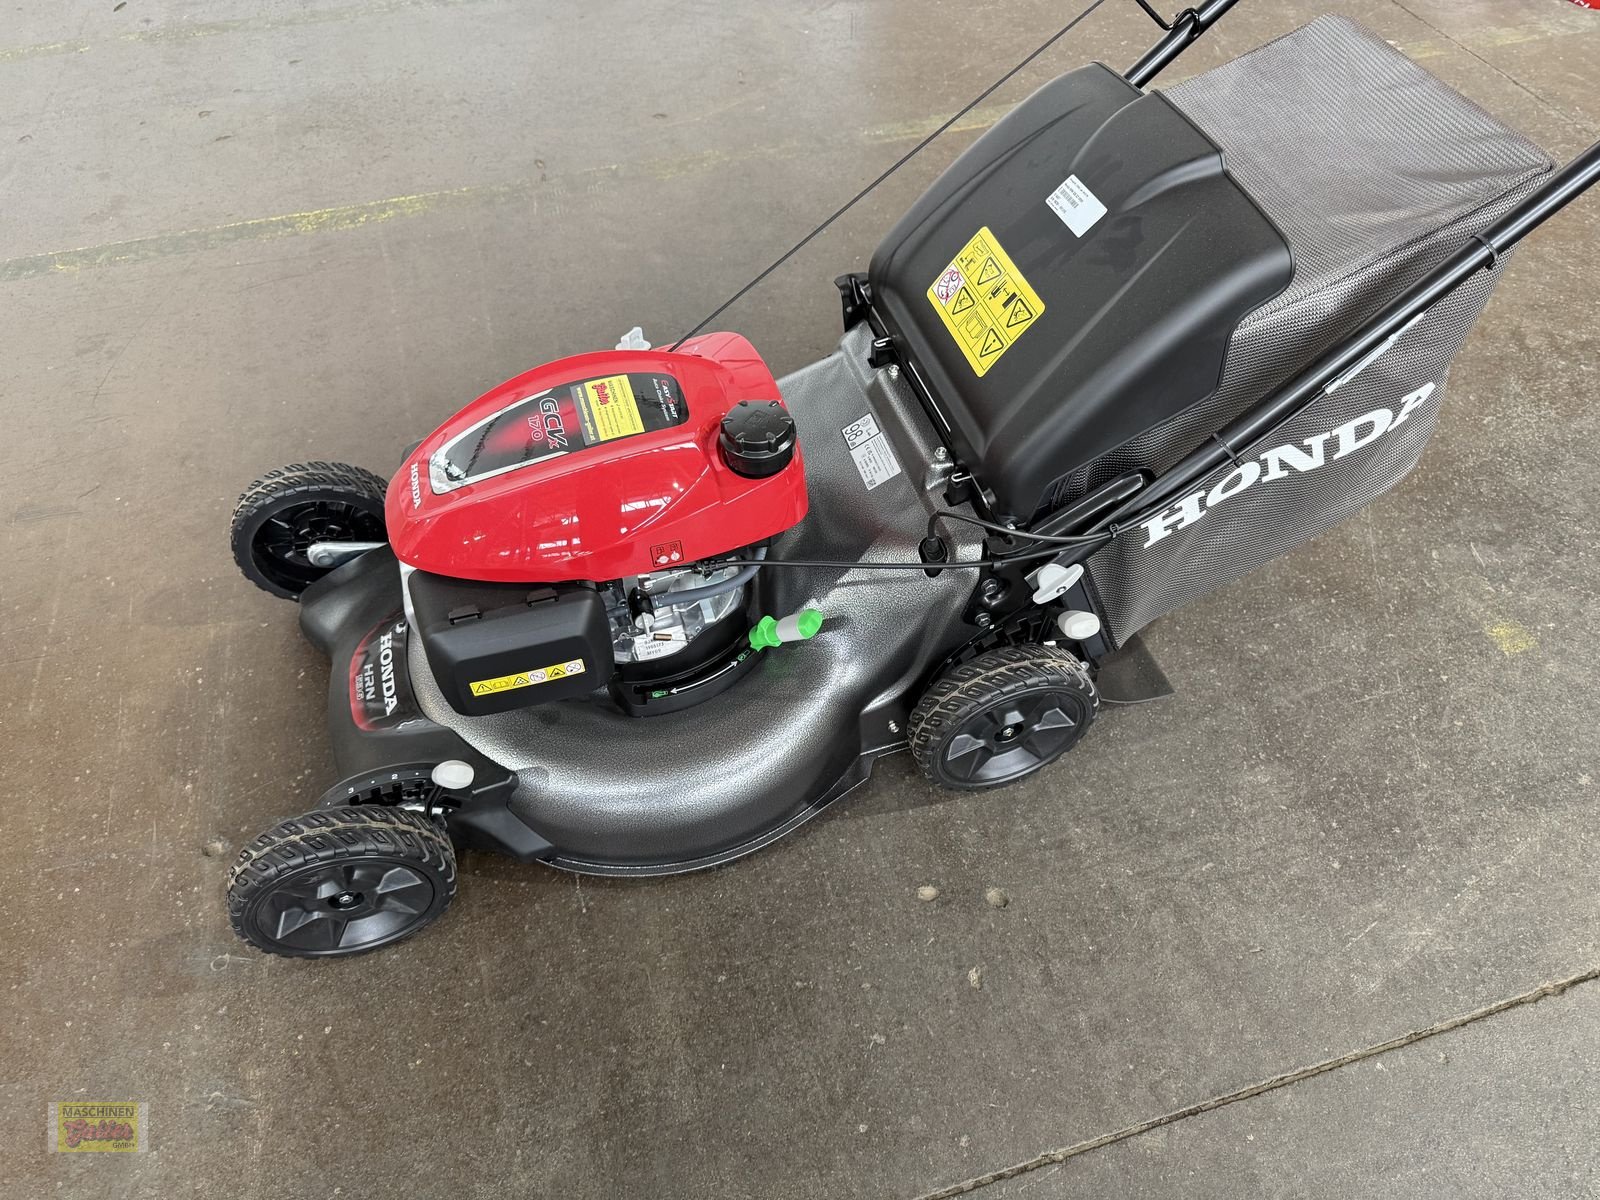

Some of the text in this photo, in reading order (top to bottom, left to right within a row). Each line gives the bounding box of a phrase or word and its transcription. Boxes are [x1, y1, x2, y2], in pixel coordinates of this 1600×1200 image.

[656, 389, 664, 403] Choke
[661, 403, 669, 421] System
[528, 415, 543, 441] 170
[844, 423, 863, 441] 98
[1140, 382, 1436, 549] HONDA
[410, 462, 421, 509] HONDA
[363, 663, 376, 700] HRN
[380, 632, 398, 716] HONDA
